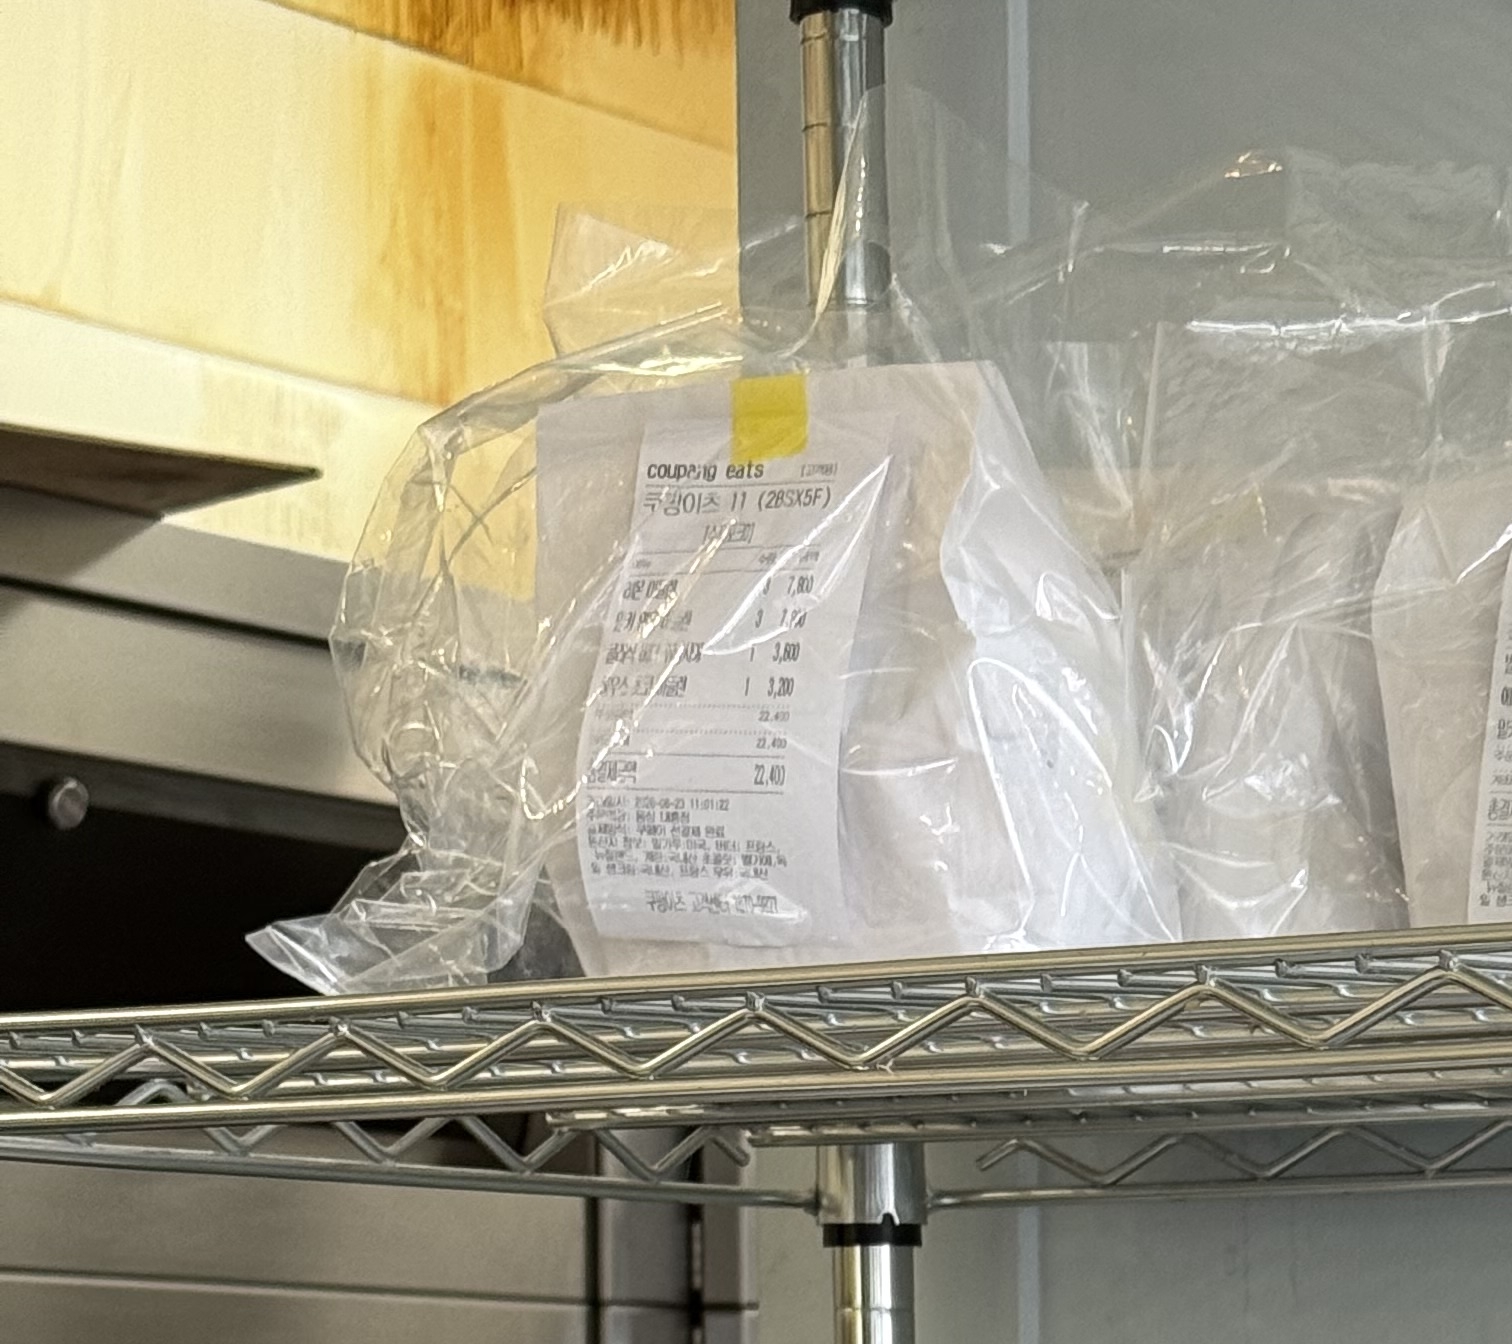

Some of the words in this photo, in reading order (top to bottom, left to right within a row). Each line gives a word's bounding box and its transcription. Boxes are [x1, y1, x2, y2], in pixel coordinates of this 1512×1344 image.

[647, 462, 717, 481] coupang
[726, 460, 764, 479] eats
[731, 490, 747, 512] 11
[754, 764, 786, 787] 22,400
